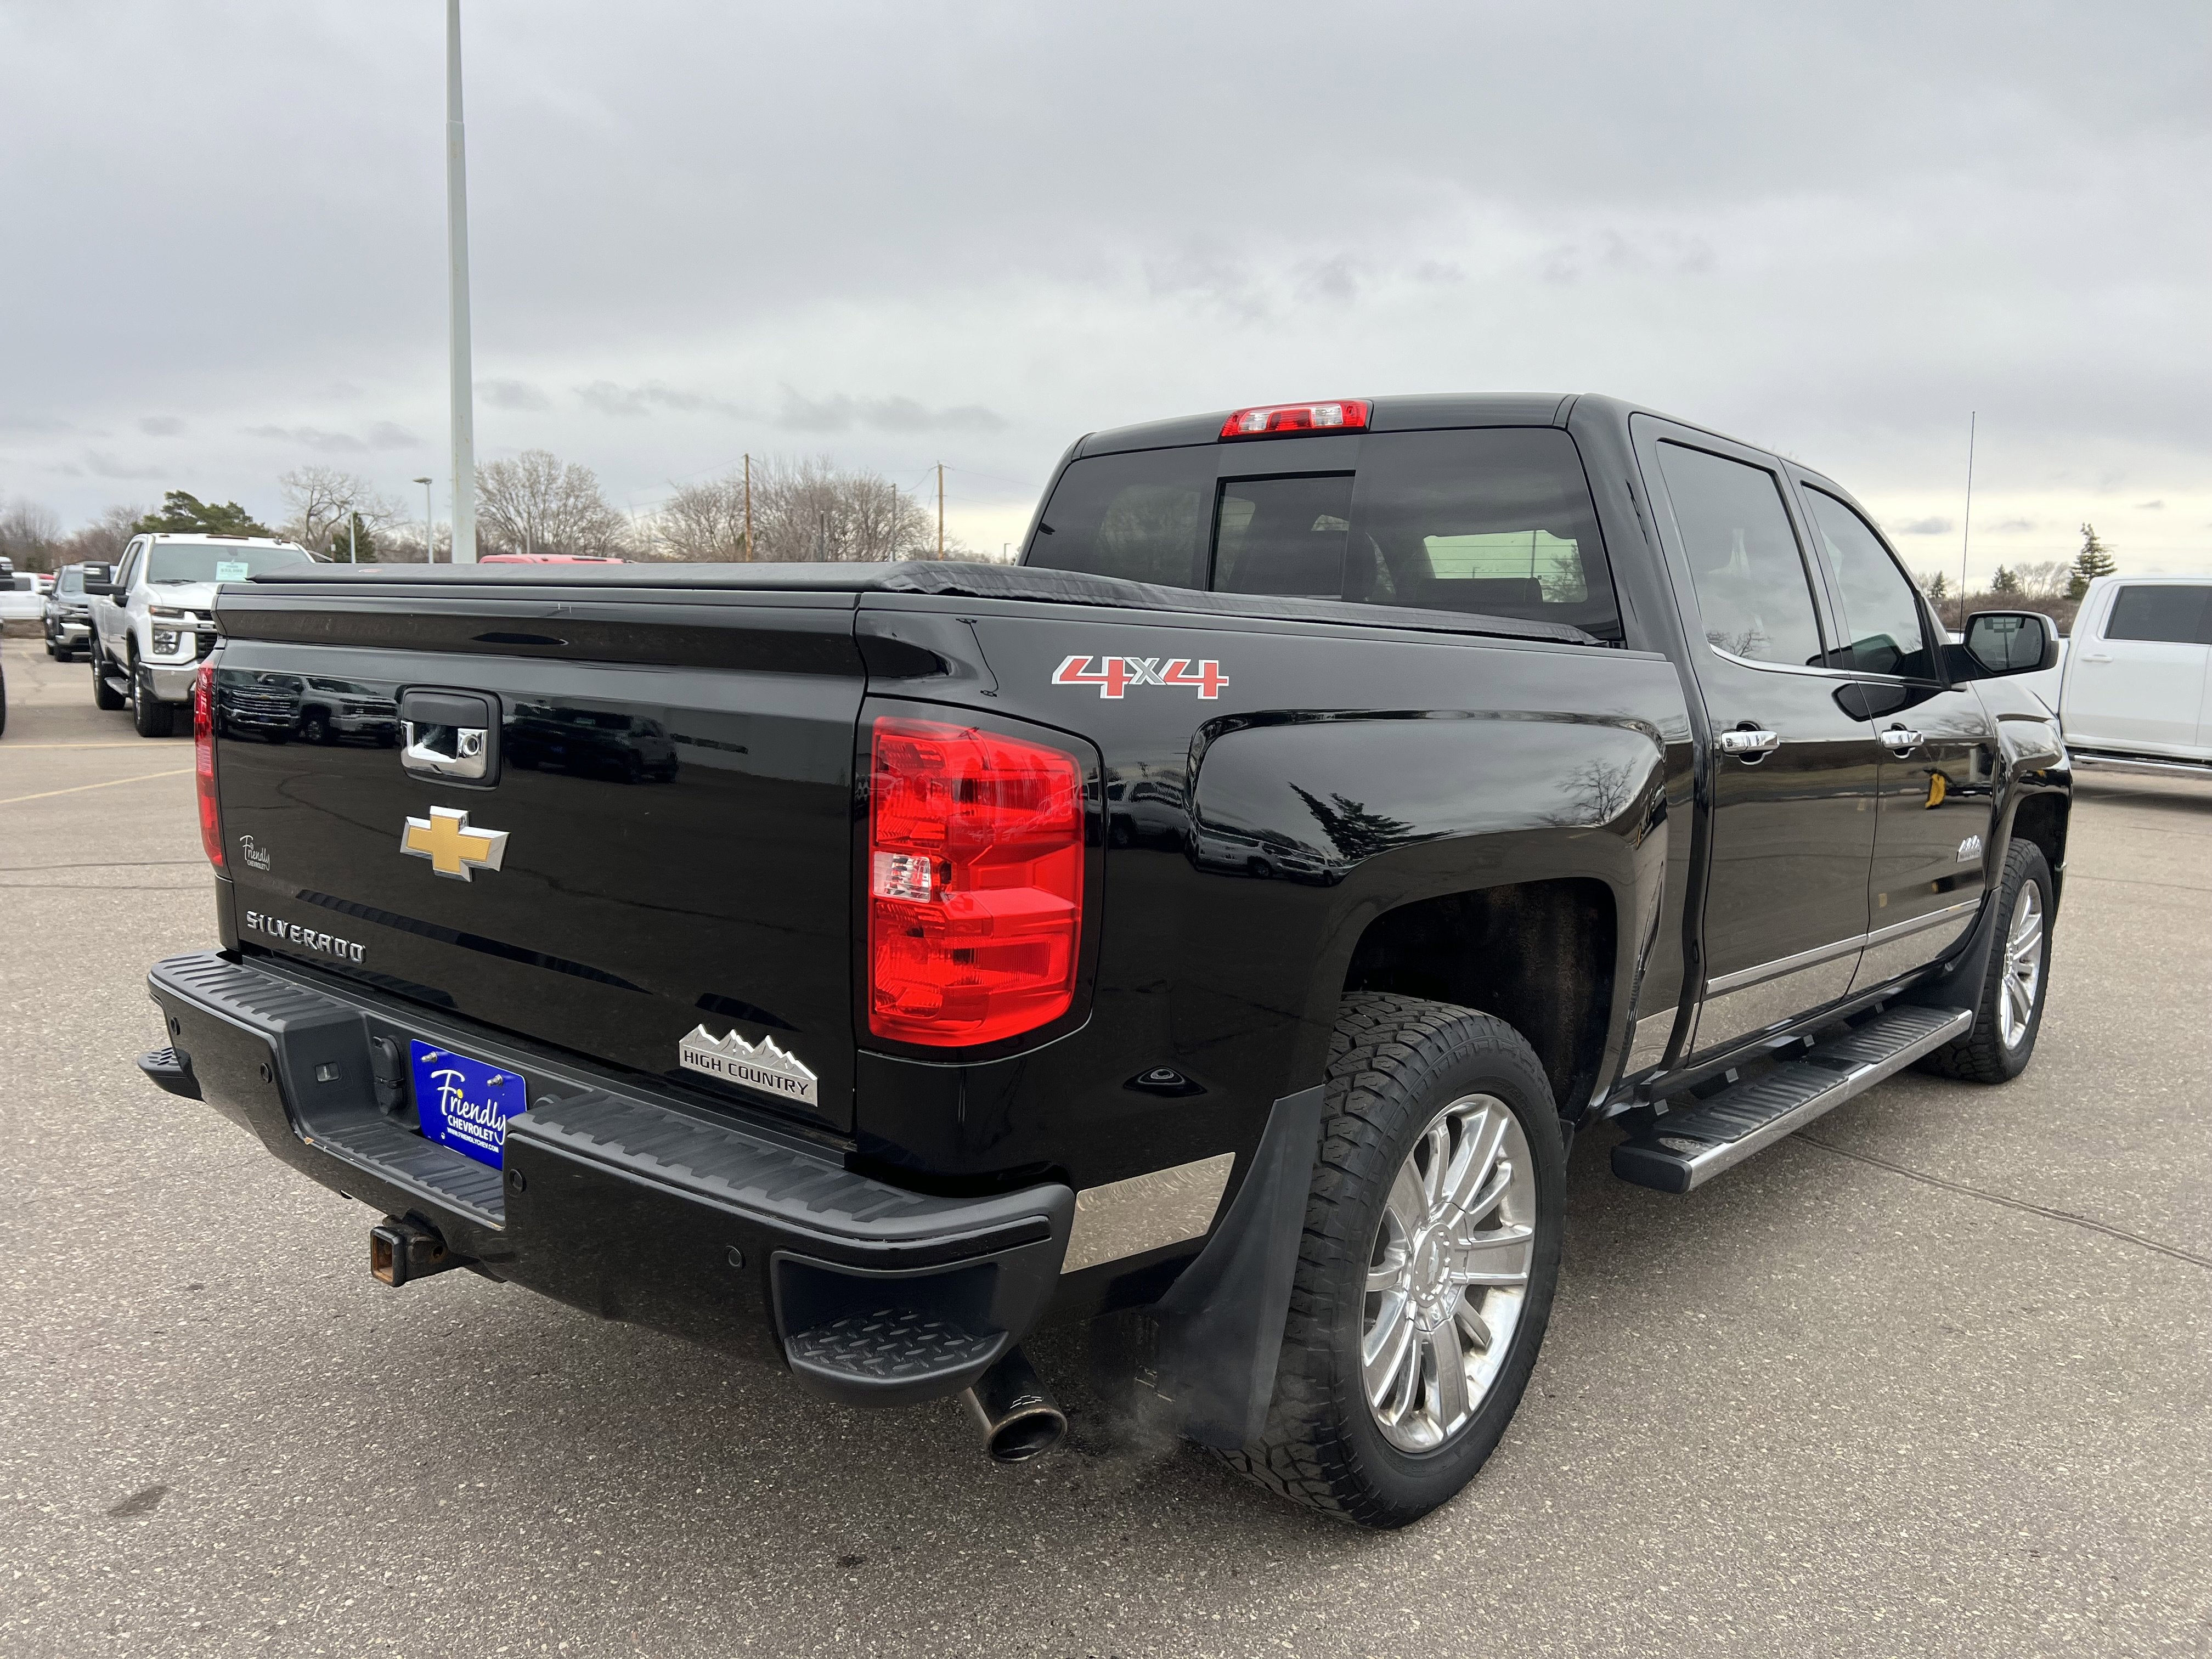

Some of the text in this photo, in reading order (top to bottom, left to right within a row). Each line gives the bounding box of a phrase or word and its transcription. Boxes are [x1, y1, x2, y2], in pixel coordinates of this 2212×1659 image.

[240, 835, 270, 871] Friendly
[247, 910, 366, 963] SILVERADO
[684, 1050, 809, 1096] HIGH COUNTRY
[431, 1069, 505, 1146] Friendly
[448, 1115, 494, 1142] CHEVROLET
